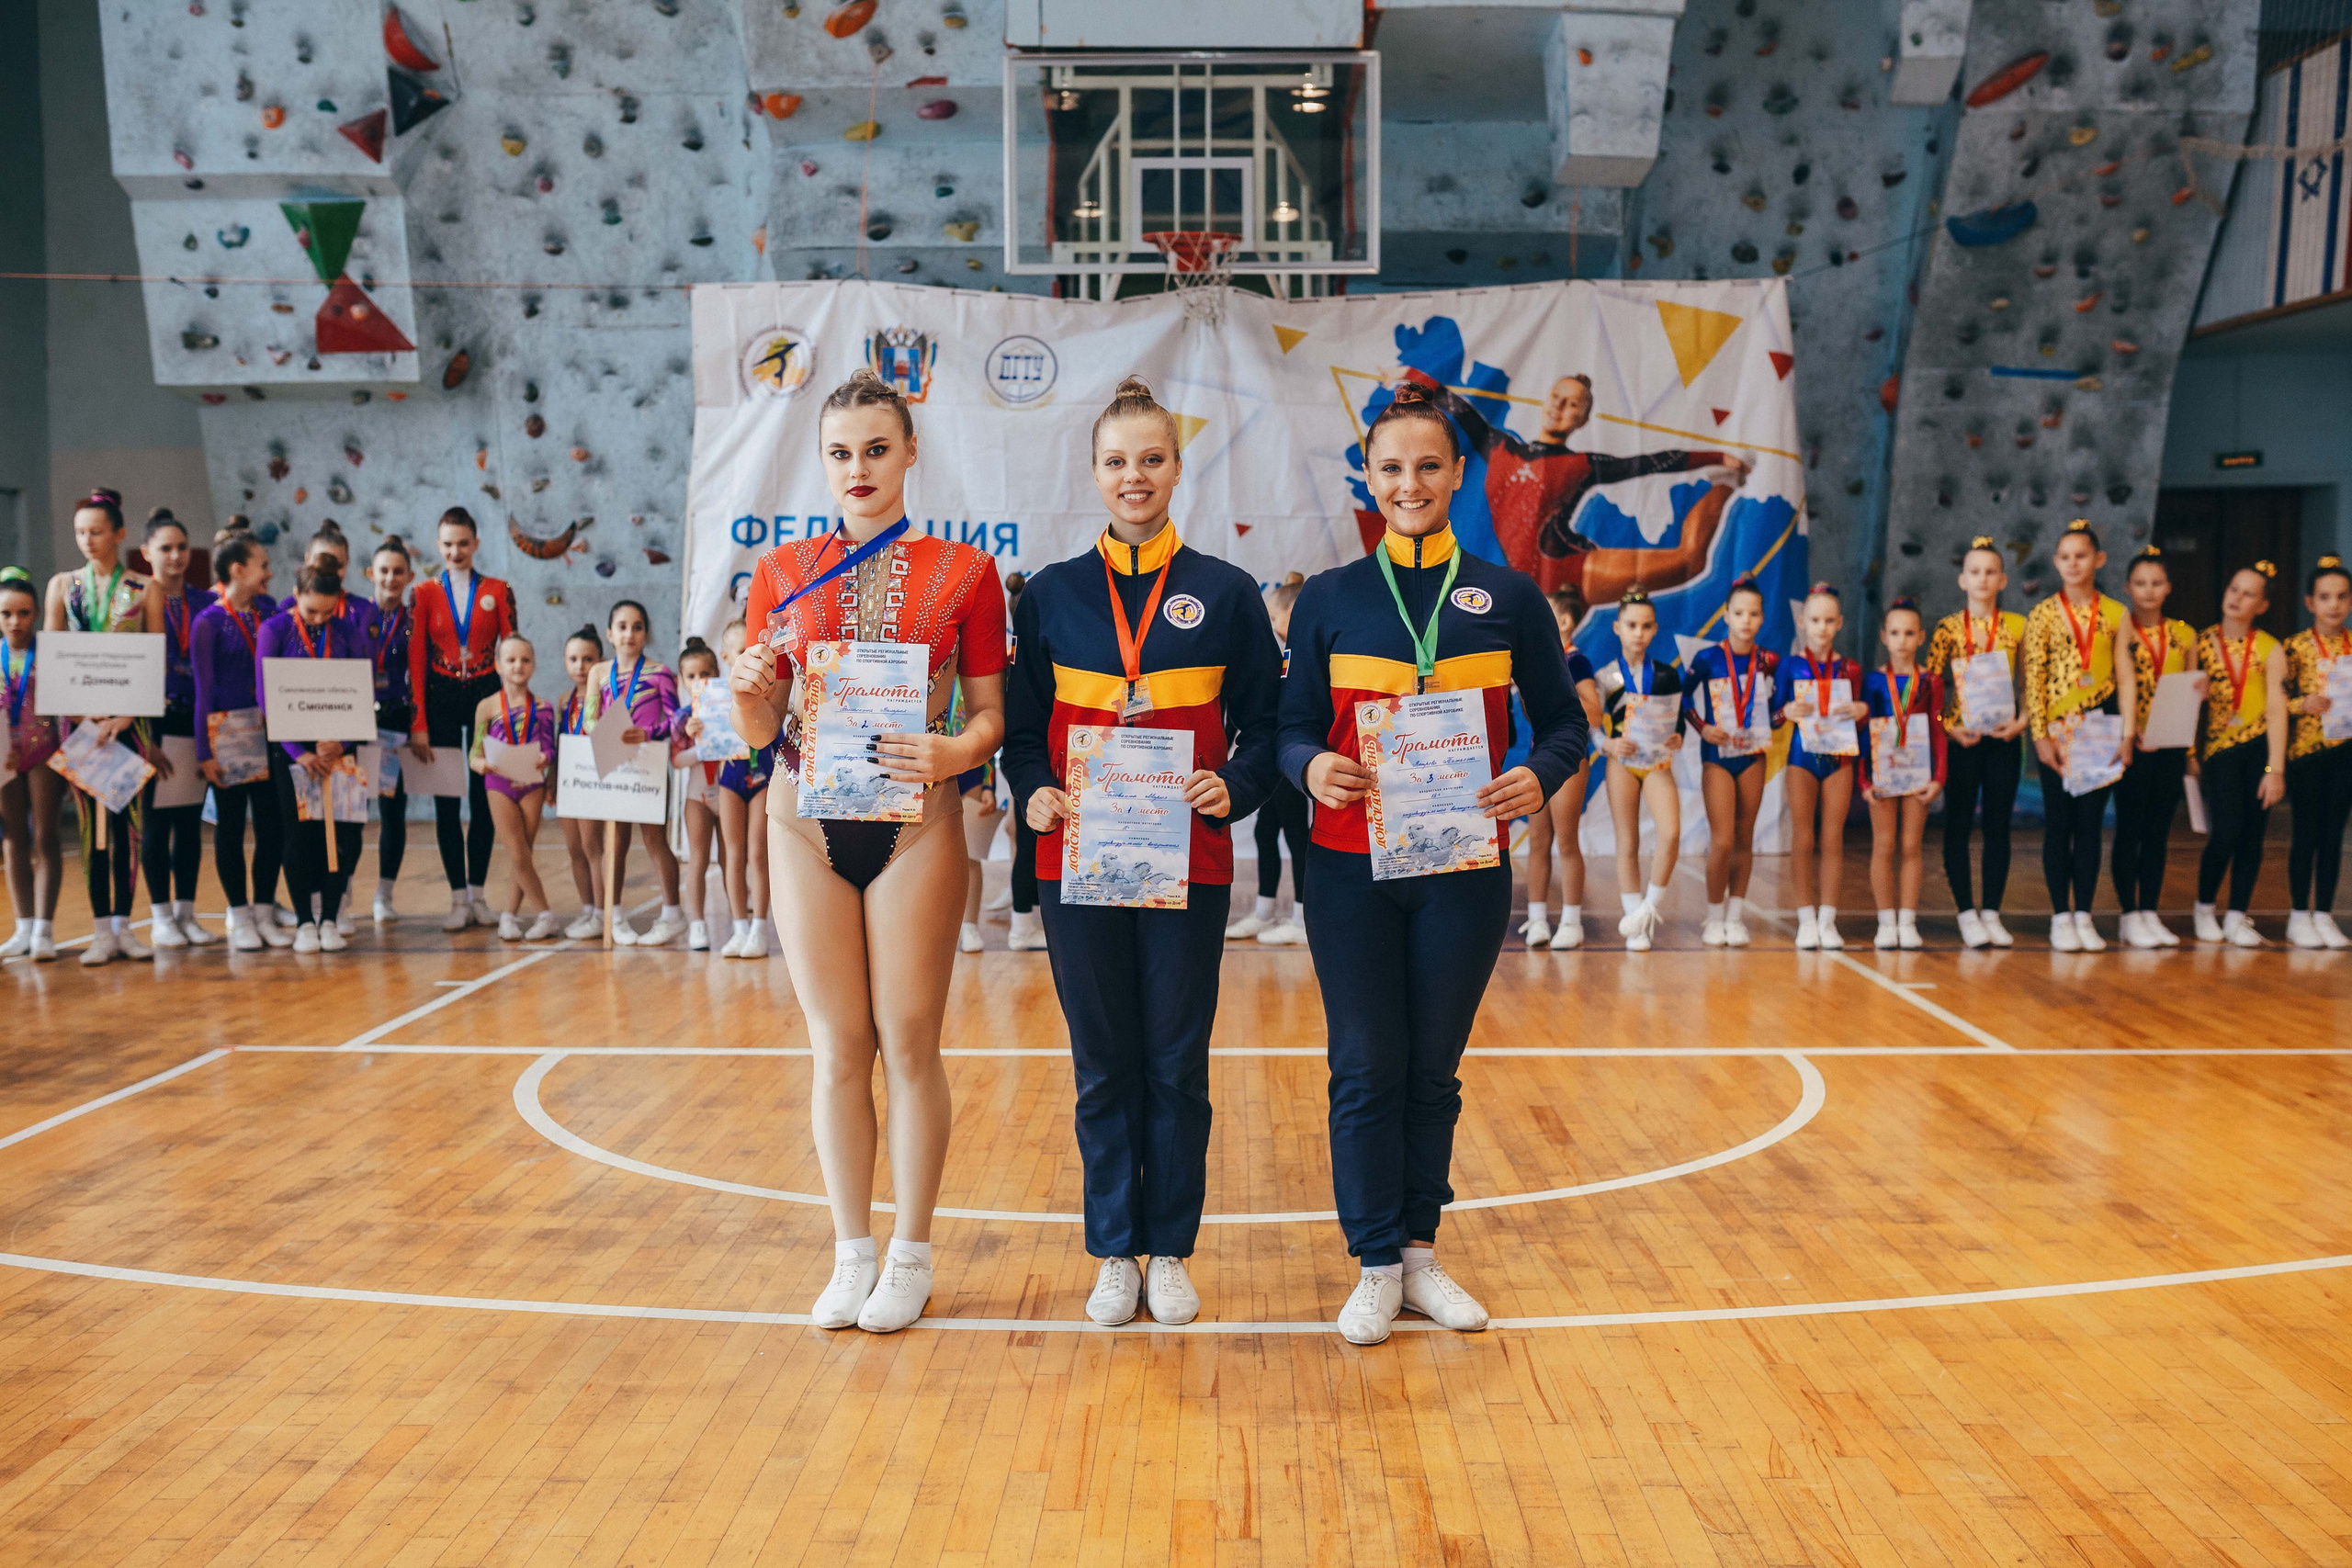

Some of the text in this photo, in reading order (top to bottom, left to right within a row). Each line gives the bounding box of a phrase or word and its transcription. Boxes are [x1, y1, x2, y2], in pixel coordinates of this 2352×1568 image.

[999, 355, 1044, 381] ДГТУ
[731, 514, 1018, 557] ФЕДЦИЯ
[82, 674, 130, 687] Донецк
[833, 677, 922, 706] Грамота
[298, 700, 353, 713] Смоленск
[808, 679, 821, 724] ОСЕНЬ
[844, 716, 858, 728] За
[872, 720, 904, 729] место
[805, 727, 818, 788] ДОНСКАЯ
[1365, 740, 1380, 784] СЕНЬ
[1391, 731, 1482, 764] Грамота
[572, 777, 662, 796] Ростов-на-Дону
[1071, 764, 1083, 808] ОСЕНЬ
[1097, 761, 1185, 793] Грамота
[1408, 770, 1470, 784] За 3 место
[1109, 802, 1123, 814] За
[1136, 807, 1170, 816] место
[1371, 788, 1387, 850] ДОНСКАЯ
[1068, 812, 1080, 874] ДОНСКАЯ
